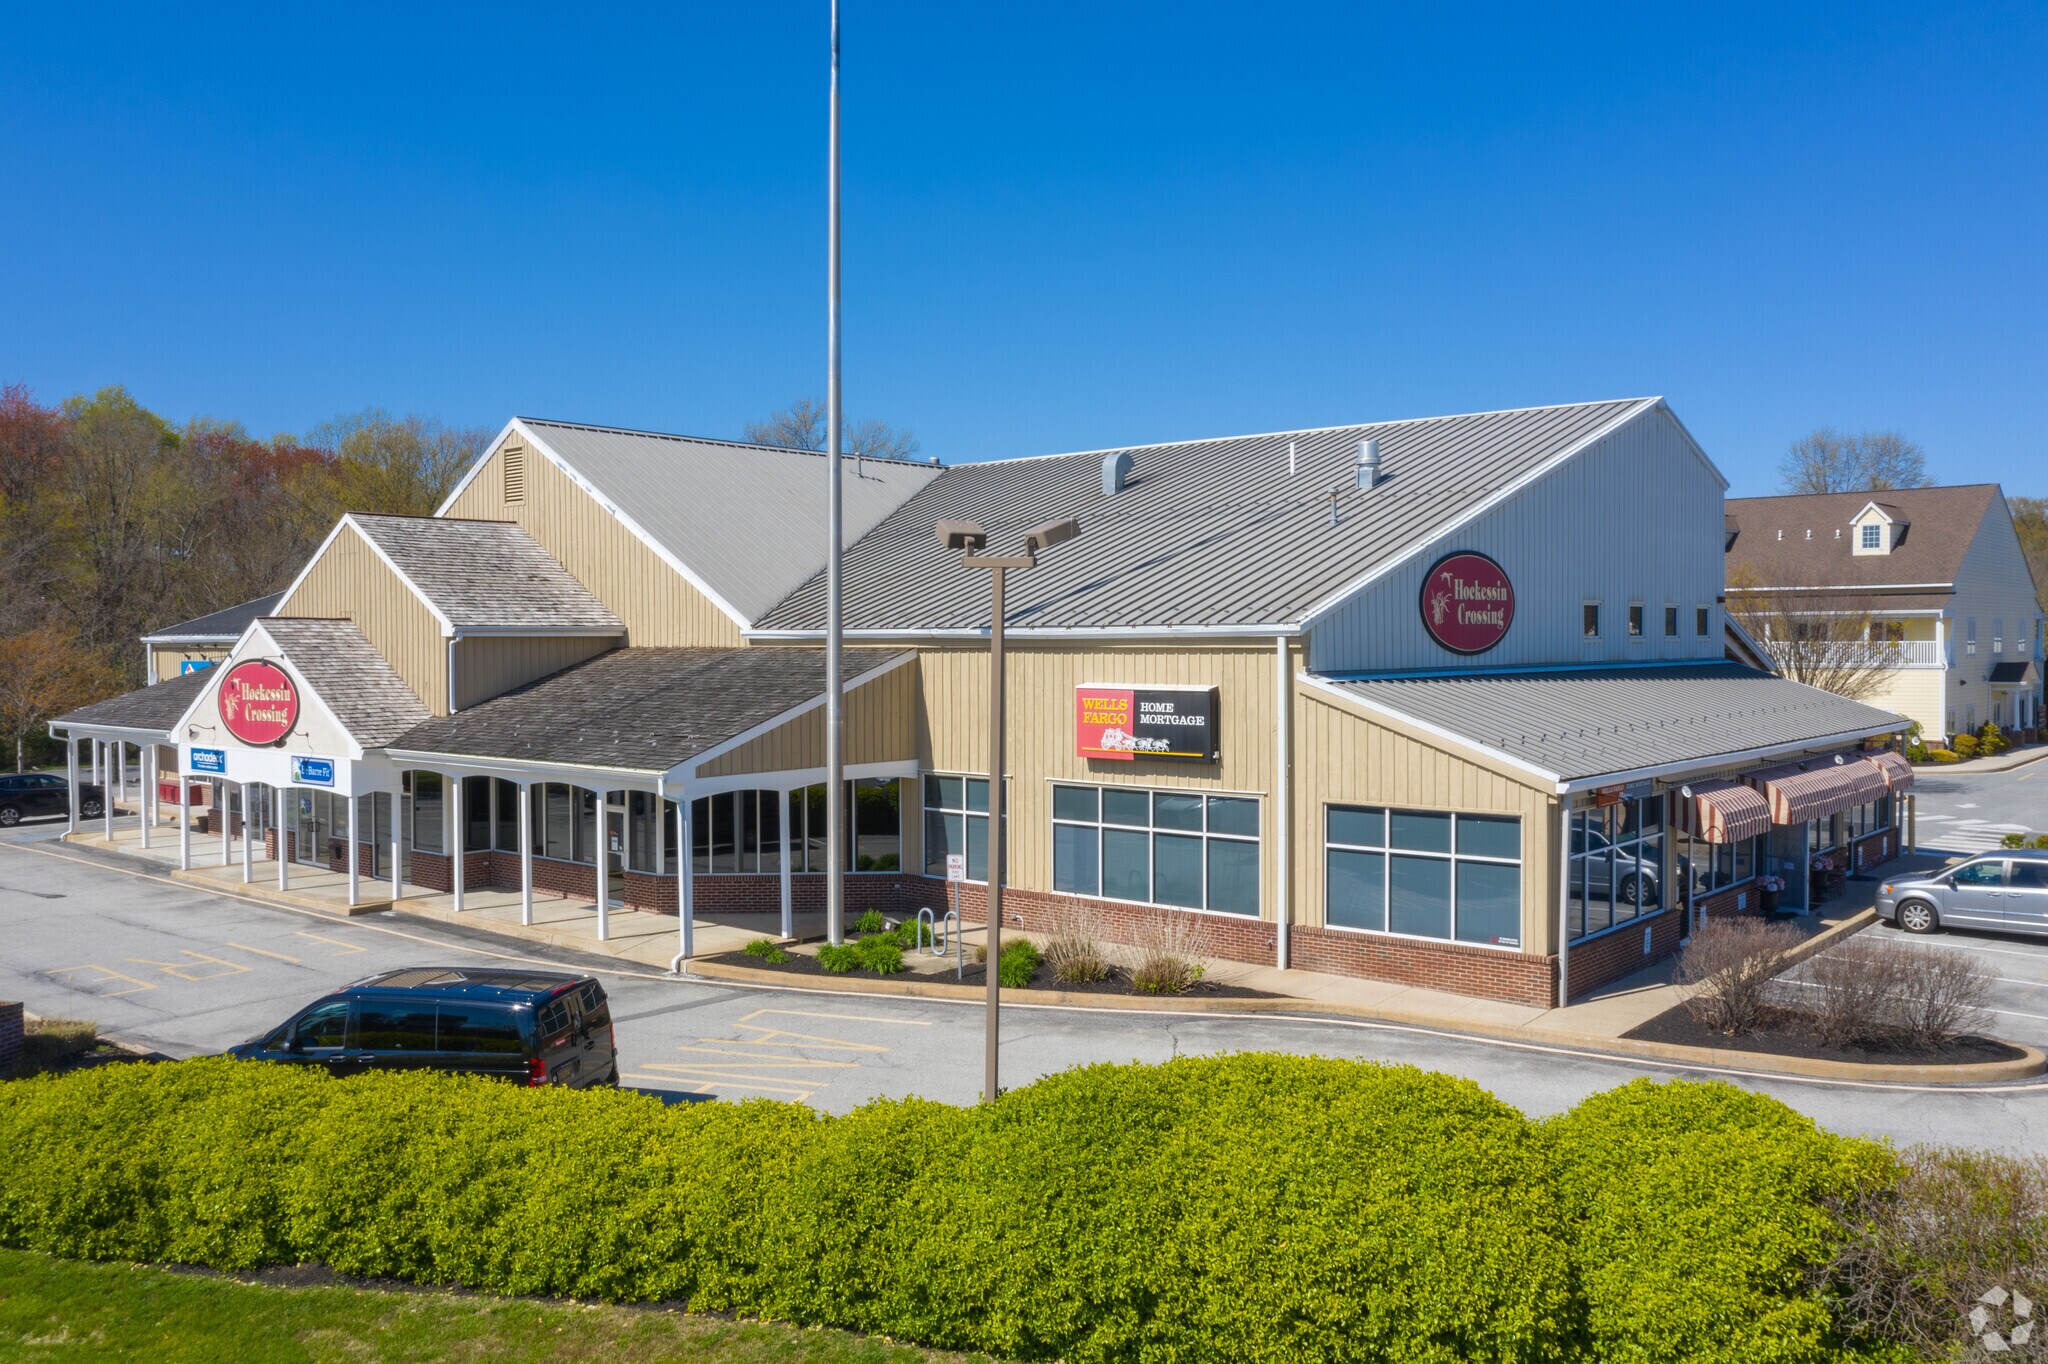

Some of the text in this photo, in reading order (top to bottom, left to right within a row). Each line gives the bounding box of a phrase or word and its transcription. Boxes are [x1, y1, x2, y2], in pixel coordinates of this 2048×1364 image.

[1454, 578, 1508, 601] Hockessin
[1457, 603, 1505, 630] Crossing
[241, 682, 291, 702] Hockessin
[1081, 697, 1129, 711] WELLS
[1140, 702, 1174, 713] HOME
[245, 702, 288, 727] Crossing
[1083, 711, 1128, 725] FARGO
[1140, 714, 1205, 726] MORTGAGE
